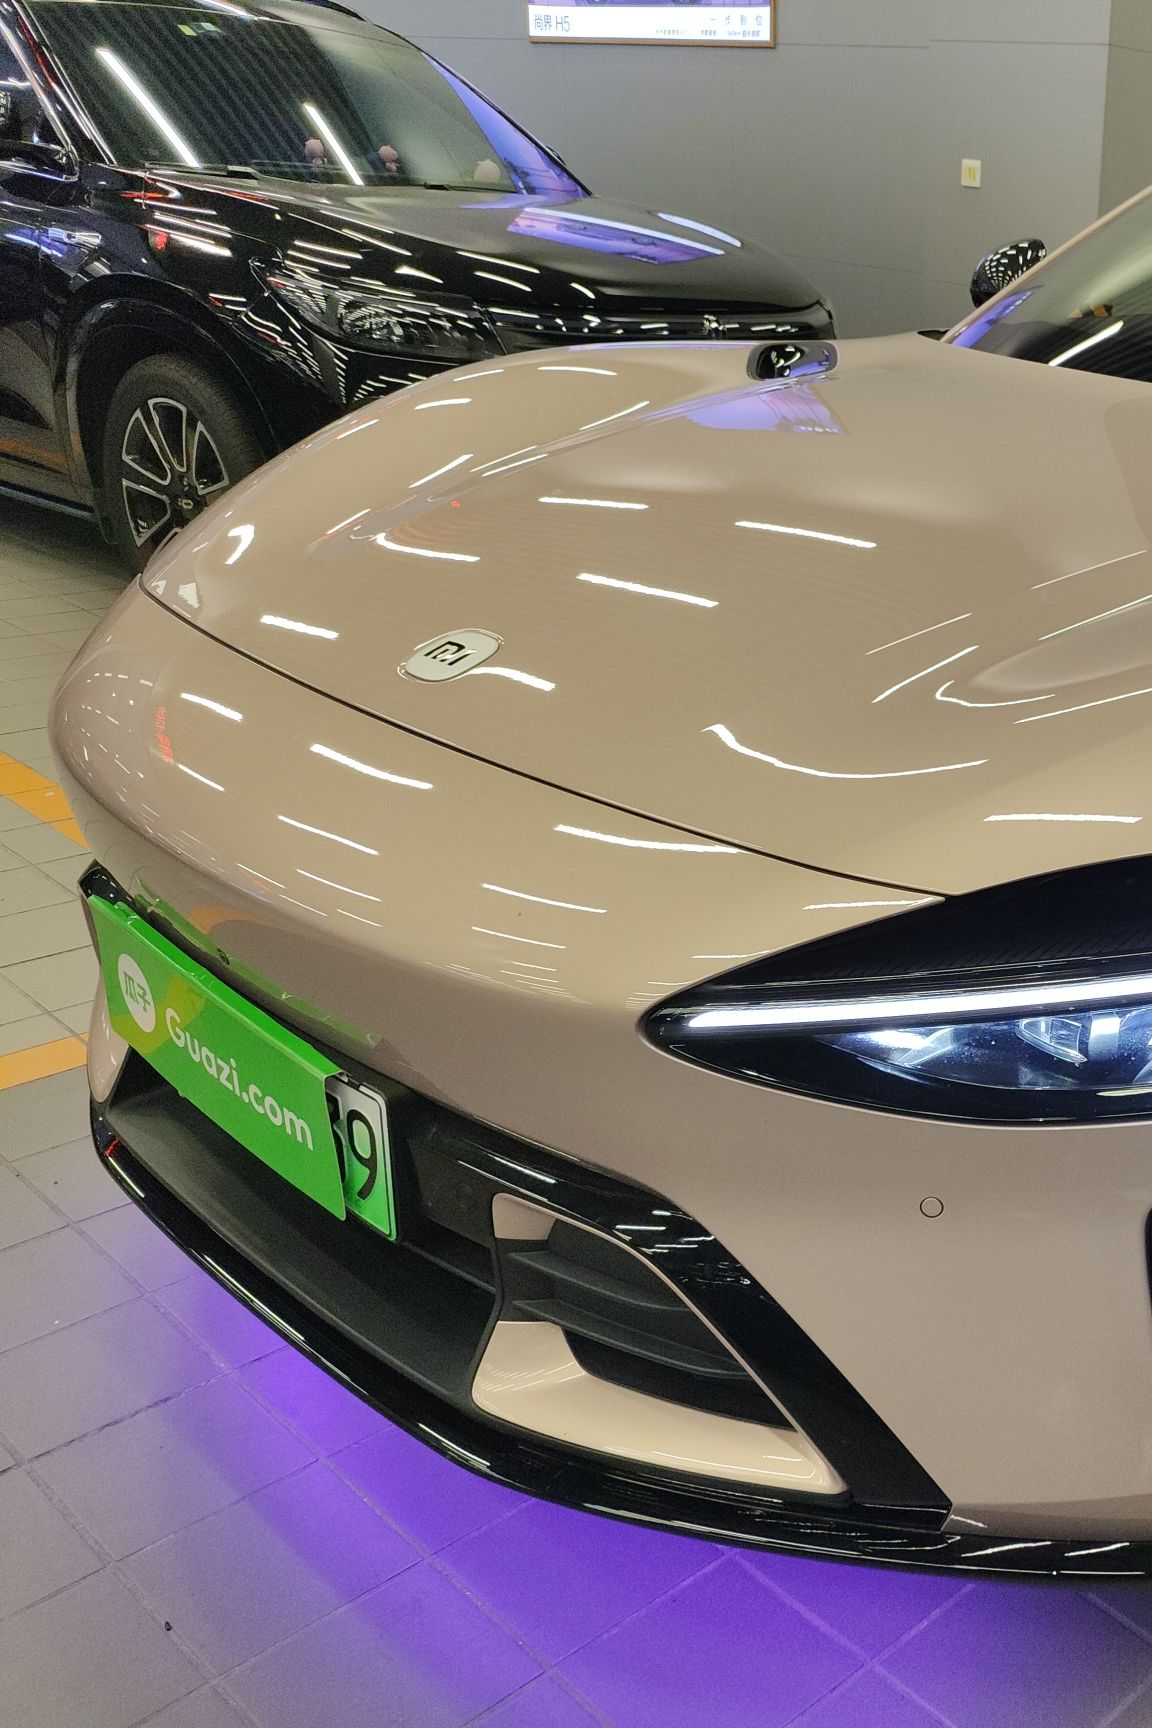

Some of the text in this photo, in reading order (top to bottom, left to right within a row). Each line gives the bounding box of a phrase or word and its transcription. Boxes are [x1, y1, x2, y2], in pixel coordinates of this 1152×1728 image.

[534, 13, 571, 32] 尚界 H5
[123, 970, 151, 1012] 瓜子
[165, 1007, 314, 1151] Guazi.com
